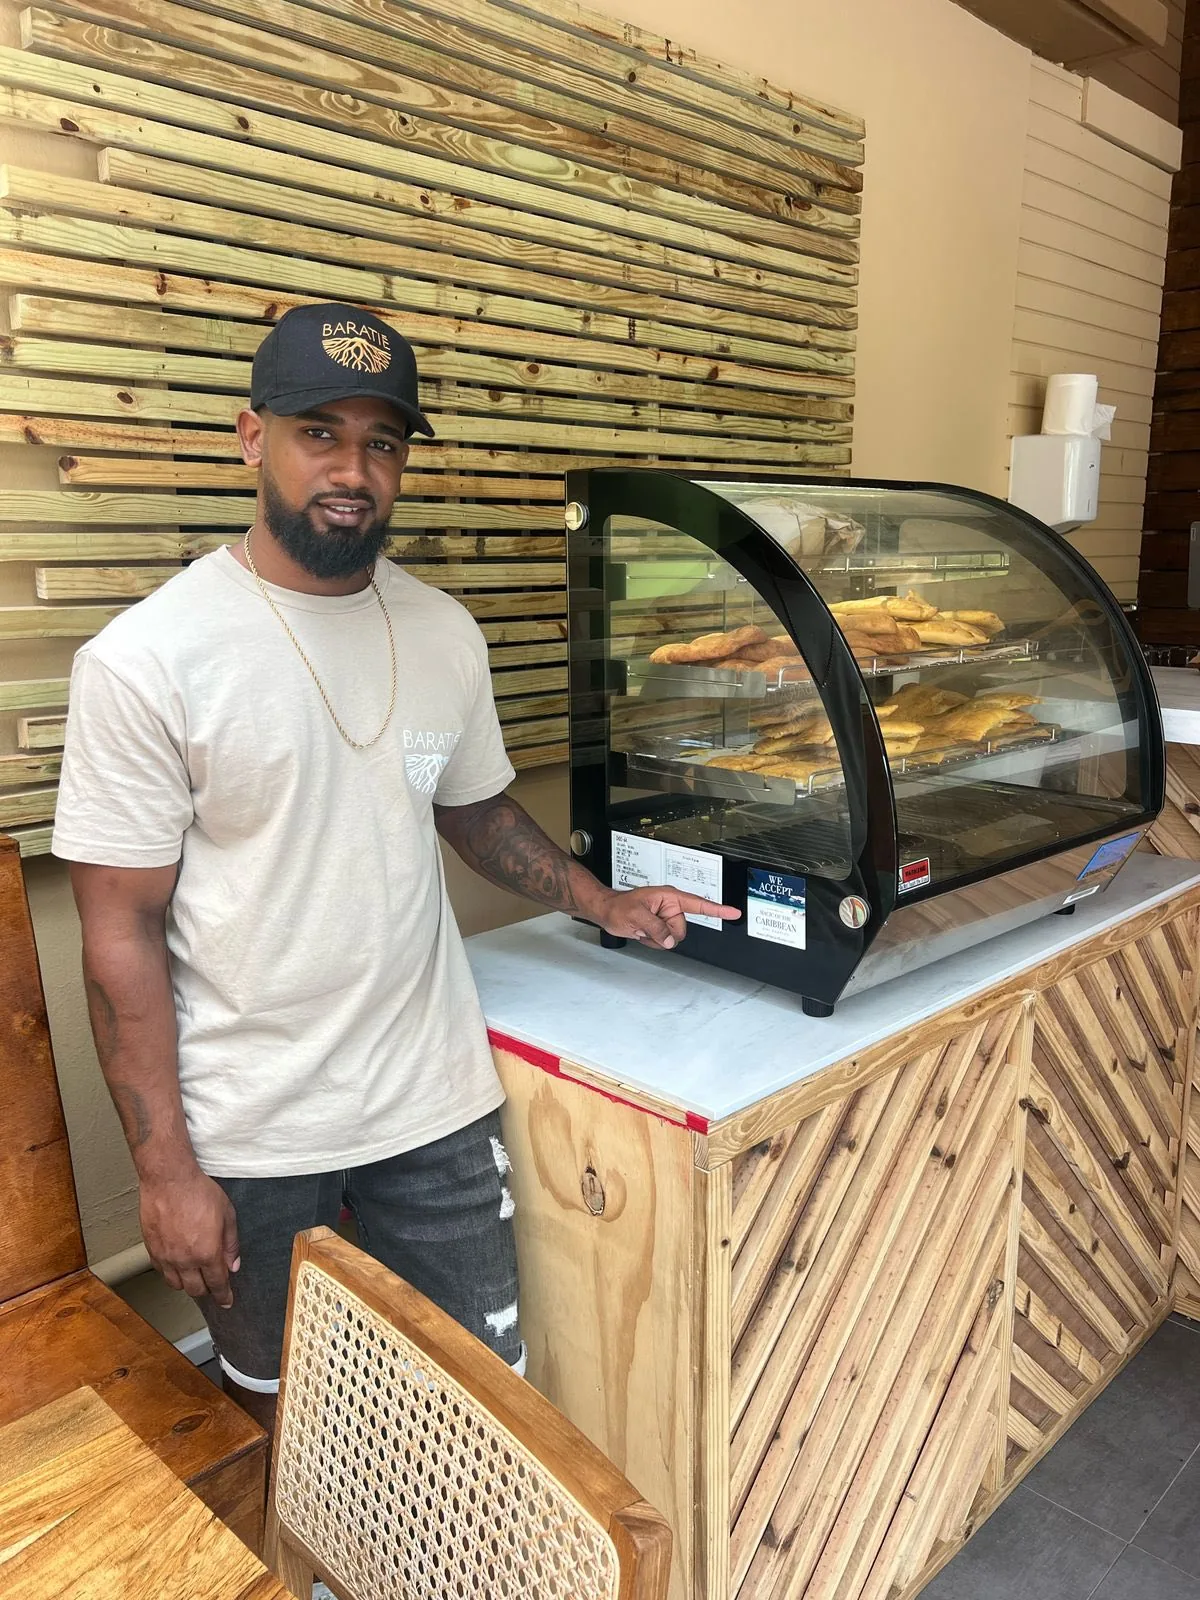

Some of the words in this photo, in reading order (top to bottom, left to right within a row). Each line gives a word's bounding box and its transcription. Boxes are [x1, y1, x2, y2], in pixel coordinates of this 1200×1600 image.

[322, 321, 391, 351] BARATIE
[768, 874, 783, 886] WE
[759, 882, 793, 897] ACCEPT
[755, 915, 797, 933] CARIBBEAN
